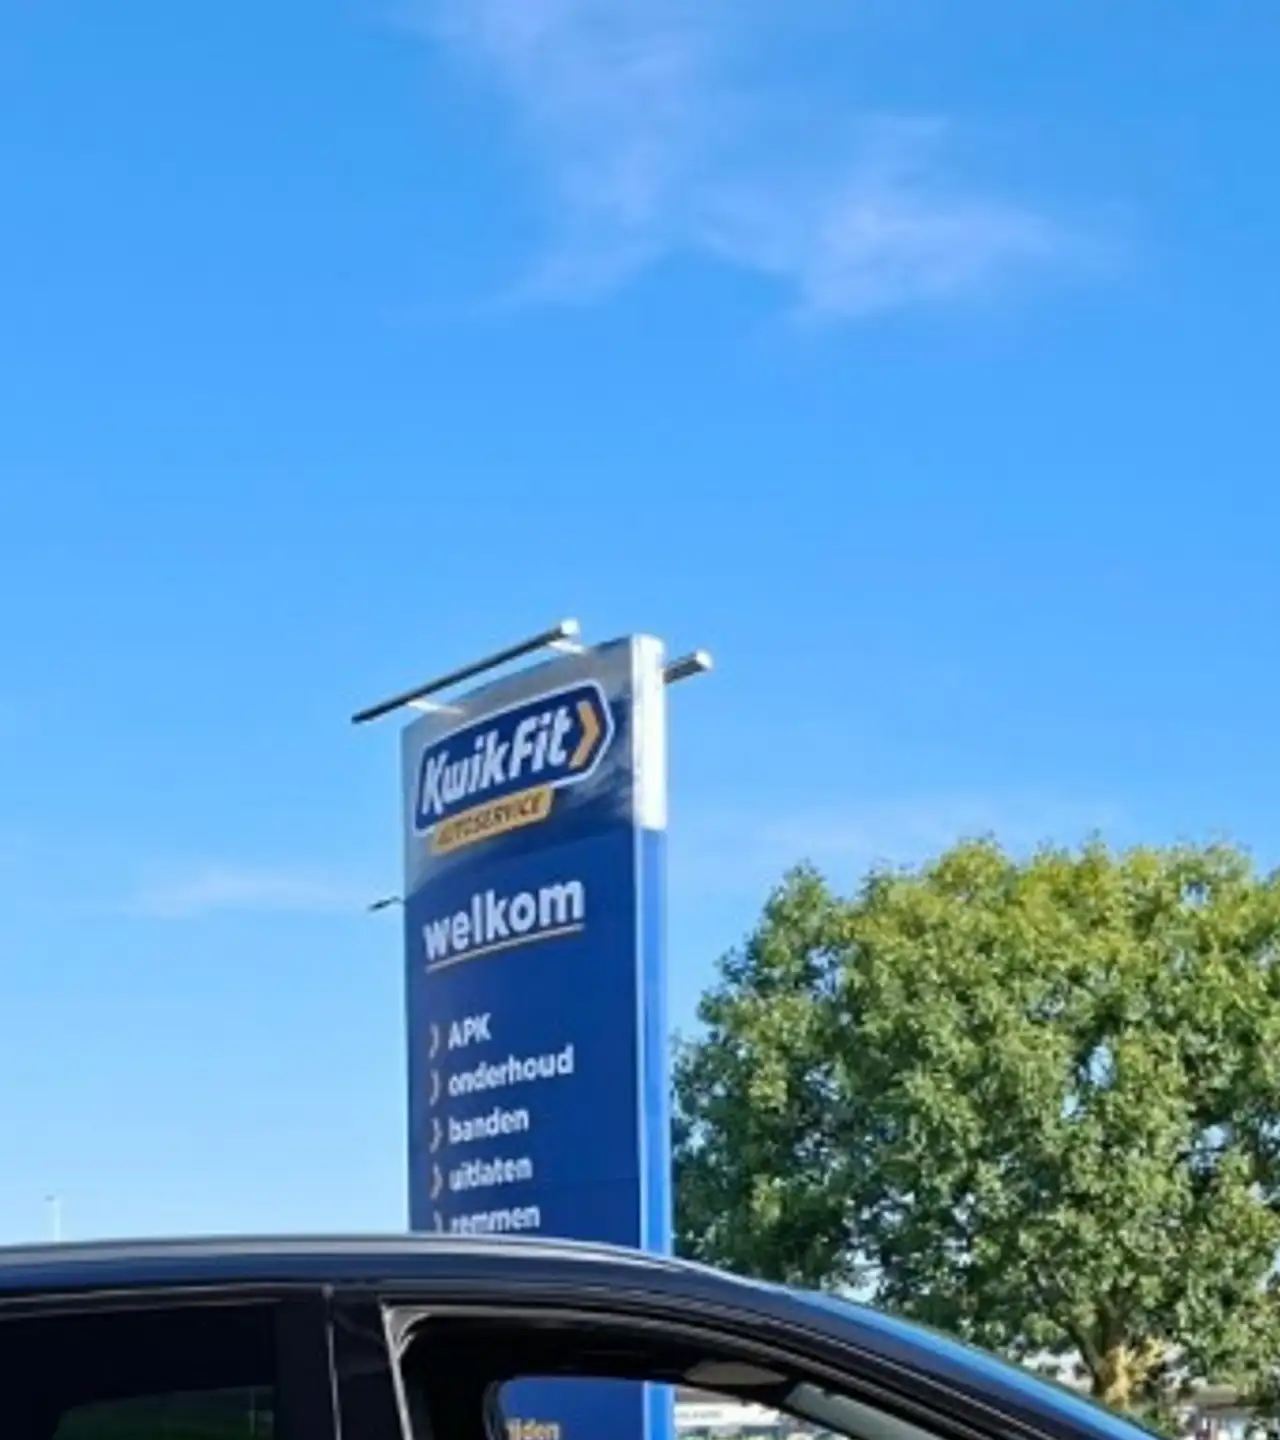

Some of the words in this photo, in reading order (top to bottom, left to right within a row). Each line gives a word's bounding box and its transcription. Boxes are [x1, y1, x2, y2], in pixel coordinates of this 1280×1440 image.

[422, 879, 585, 960] welkom
[448, 1012, 491, 1050] APK
[448, 1043, 574, 1096] onderhoud
[448, 1106, 529, 1144] banden
[448, 1156, 533, 1192] uitlaten
[451, 1205, 540, 1236] remmen
